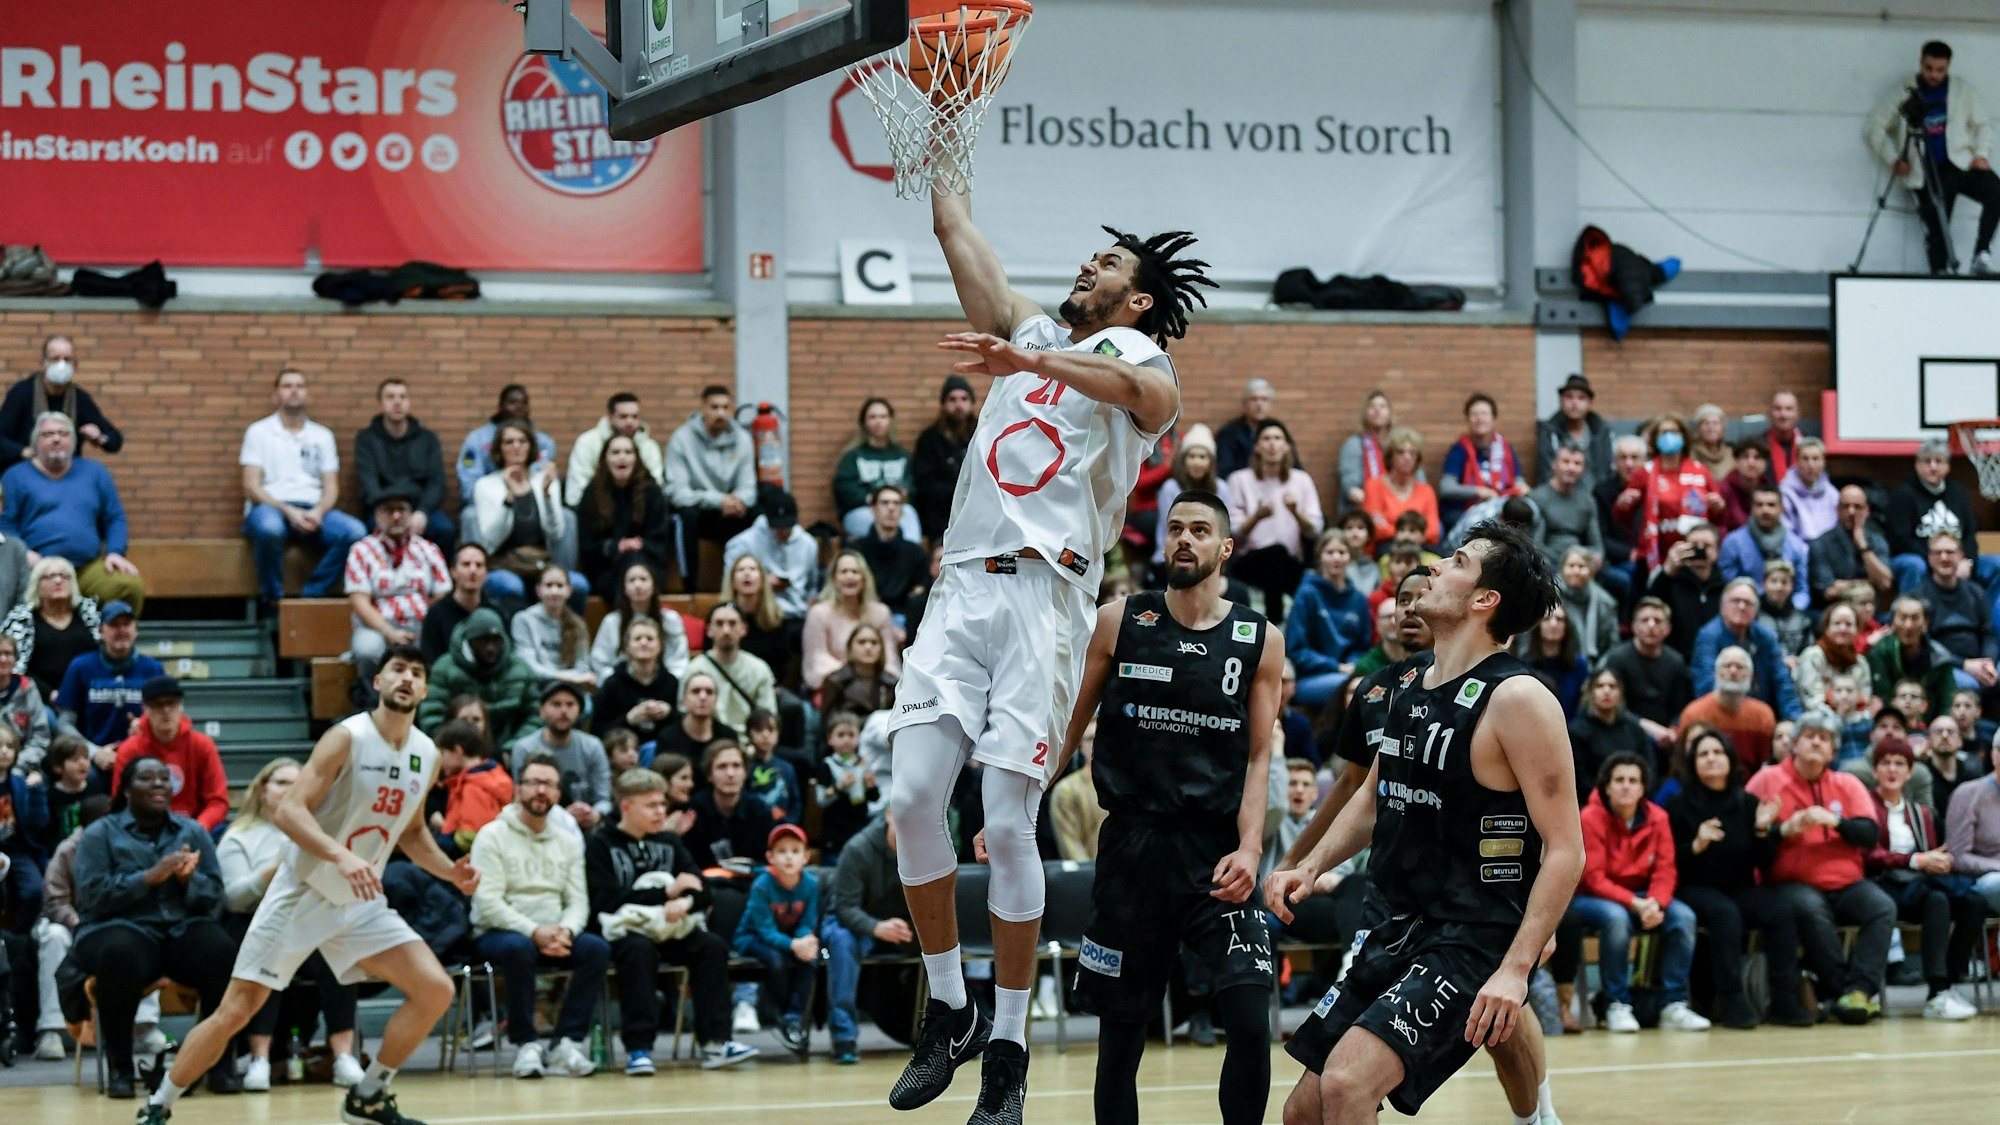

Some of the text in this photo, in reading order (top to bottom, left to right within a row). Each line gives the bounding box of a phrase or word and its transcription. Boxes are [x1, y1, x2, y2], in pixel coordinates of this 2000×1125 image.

[1, 41, 458, 117] RheinStars
[504, 94, 601, 131] RHEIN
[1001, 103, 1452, 156] Flossbach von Storch
[0, 130, 275, 164] inStarsKoeln auf
[856, 248, 897, 293] C
[1134, 665, 1171, 676] MEDICE
[1221, 657, 1243, 696] 8
[902, 695, 939, 715] SPALDING
[1137, 704, 1241, 732] KIRCHHOFF
[1137, 719, 1200, 736] AUTOMOTIVE
[1422, 721, 1455, 771] 11
[371, 786, 406, 816] 33
